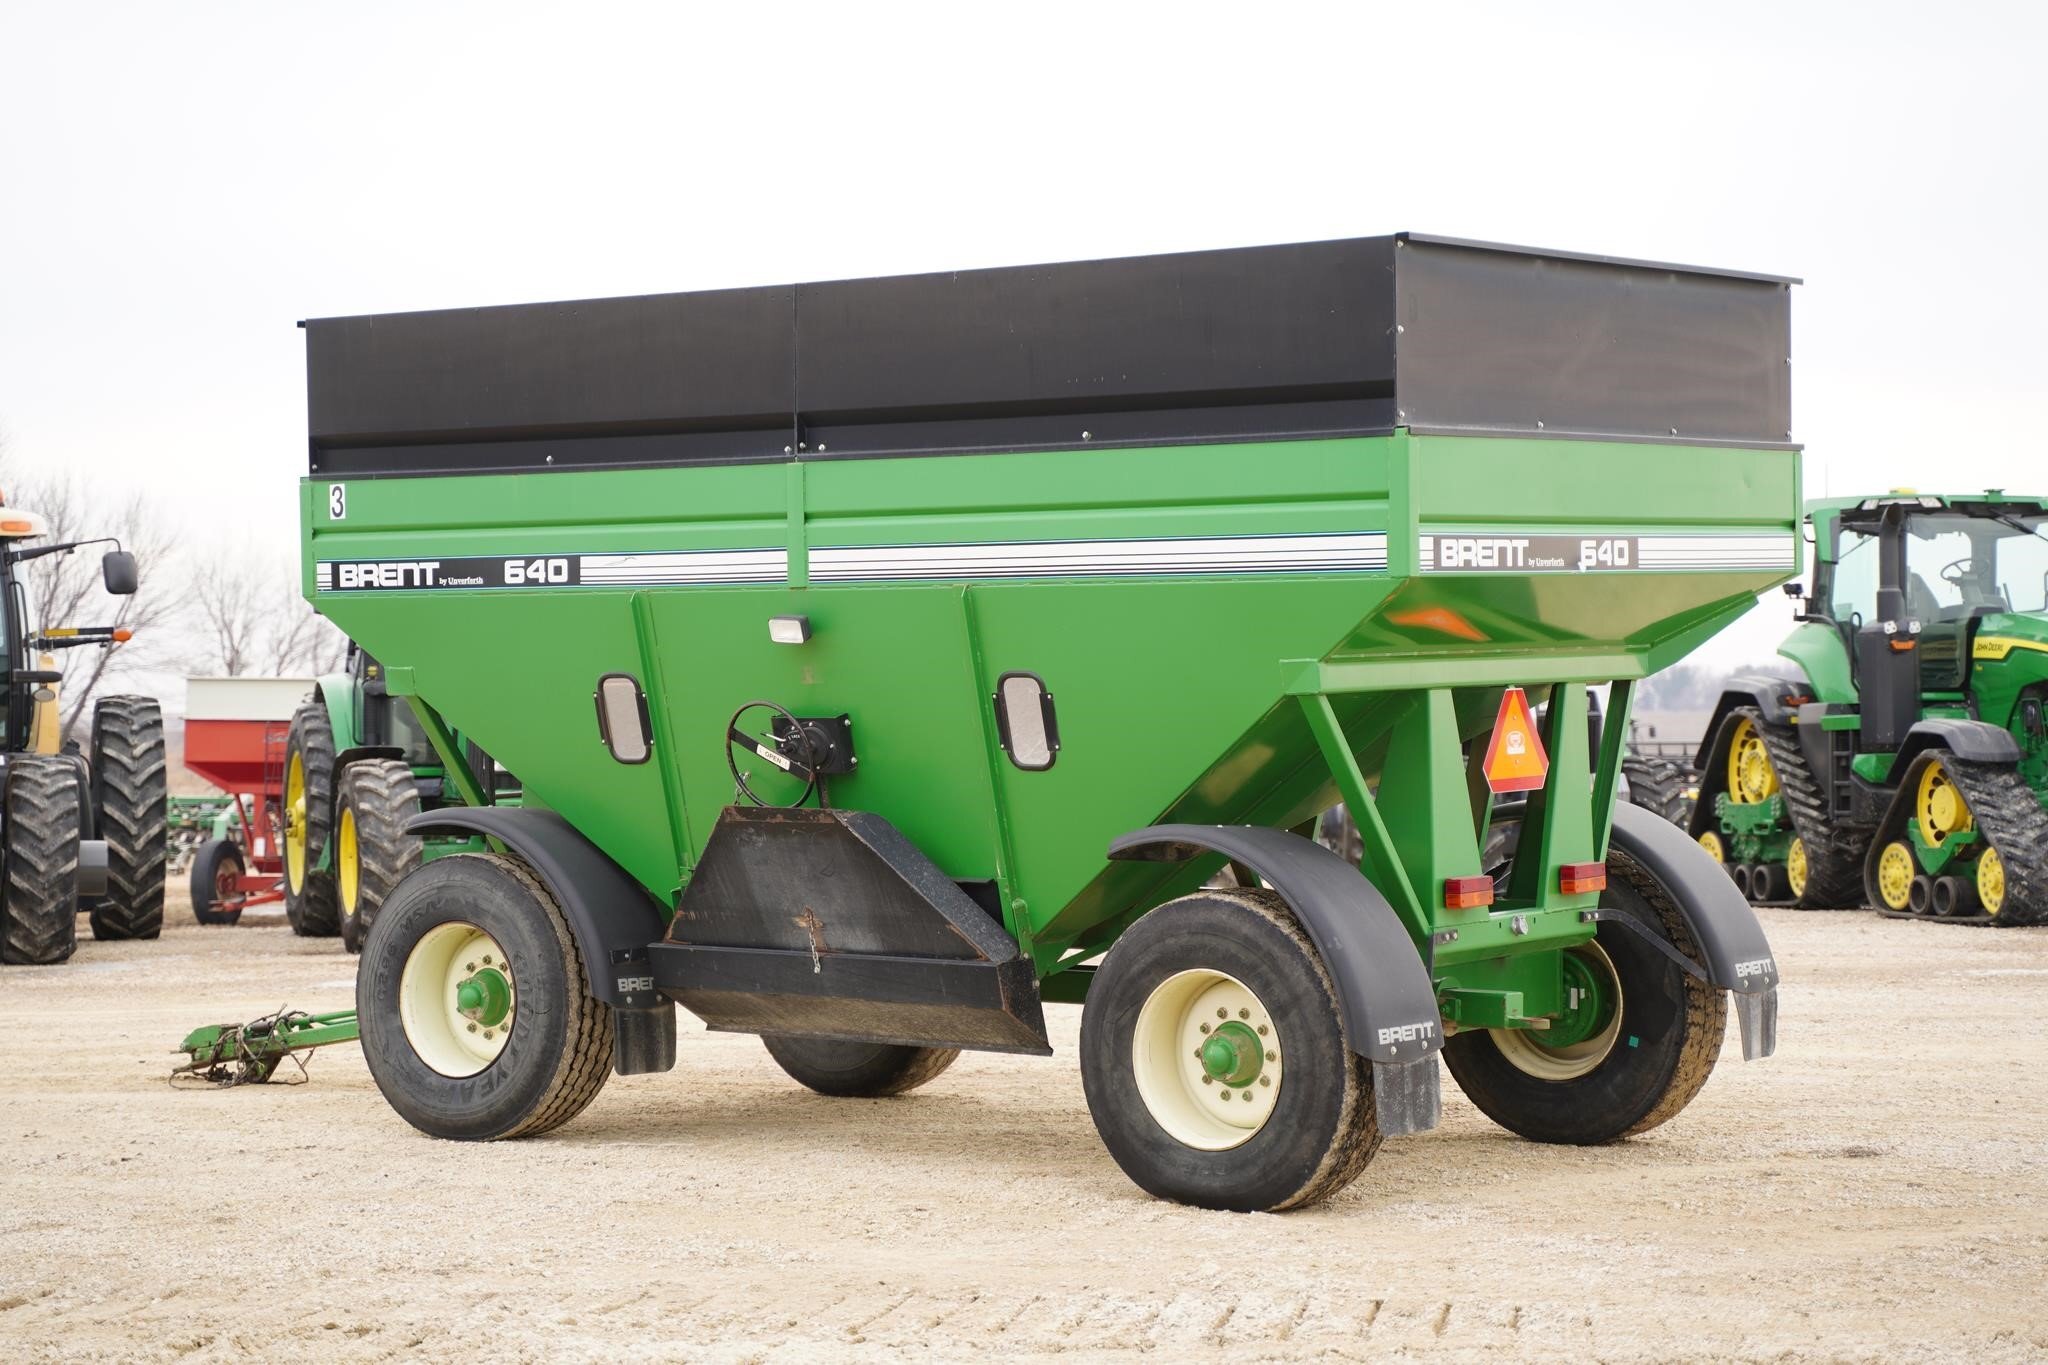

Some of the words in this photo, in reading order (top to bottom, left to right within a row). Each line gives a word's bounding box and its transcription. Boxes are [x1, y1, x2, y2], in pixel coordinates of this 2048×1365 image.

[331, 485, 344, 518] 3
[1440, 538, 1529, 567] BRENT
[1580, 539, 1630, 567] 640
[339, 561, 440, 588] BRENT
[439, 577, 447, 586] by
[504, 558, 569, 584] 640
[764, 750, 782, 765] OPEN
[1735, 958, 1771, 978] BRENT
[1378, 1020, 1434, 1045] BRENT
